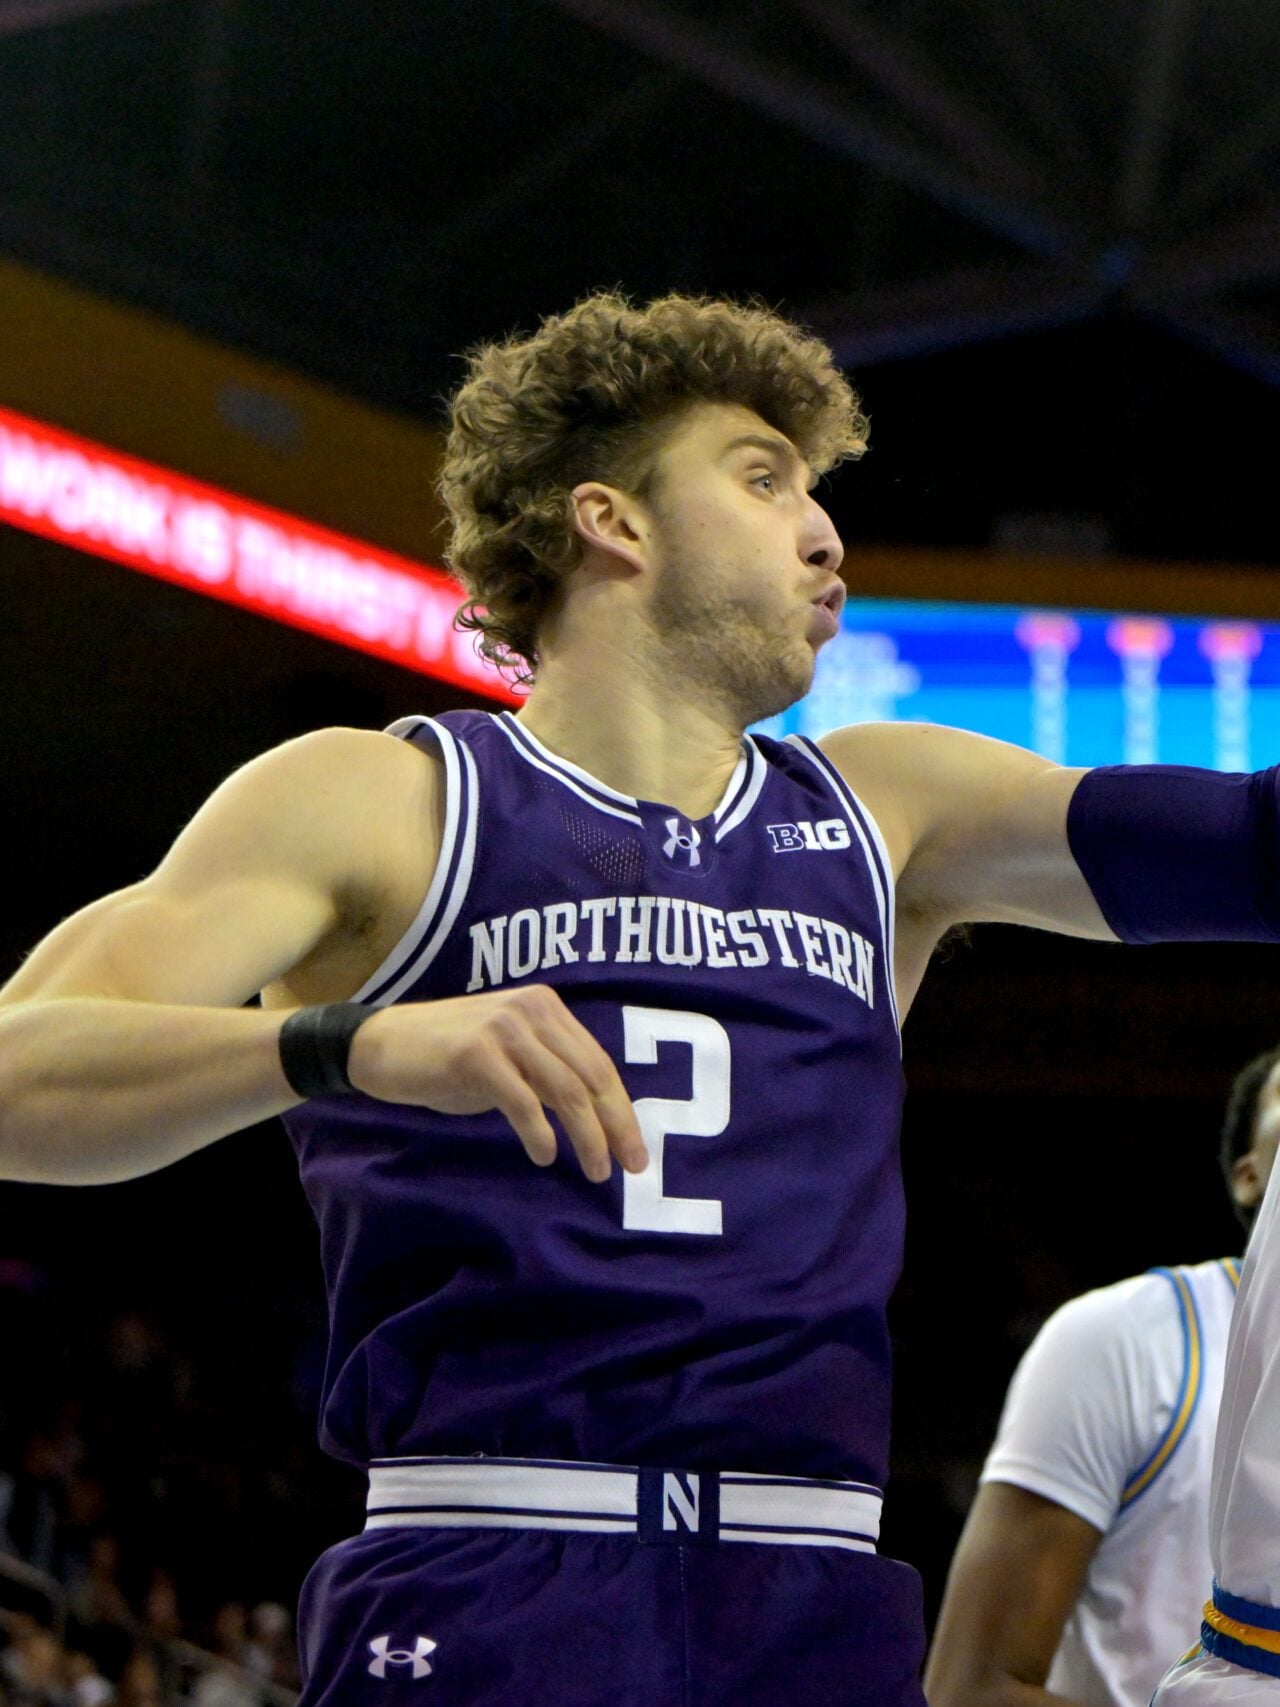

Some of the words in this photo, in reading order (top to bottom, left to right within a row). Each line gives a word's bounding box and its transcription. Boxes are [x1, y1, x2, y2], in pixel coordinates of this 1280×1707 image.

[467, 896, 875, 1010] NORTHWESTERN
[622, 1005, 732, 1236] 2
[662, 1471, 700, 1533] N
